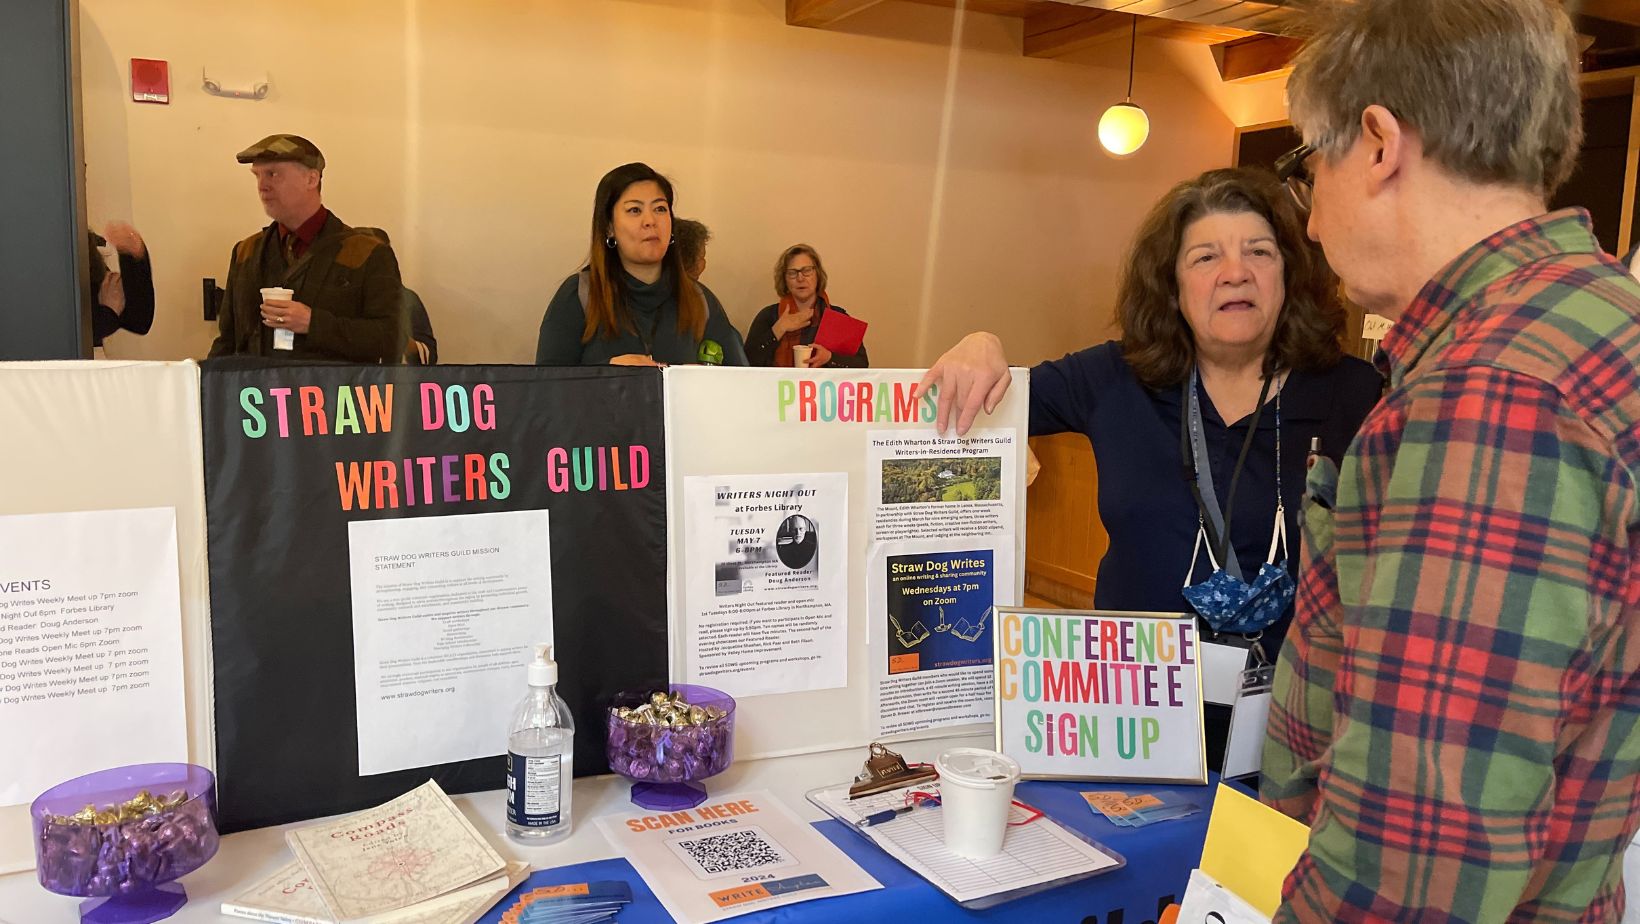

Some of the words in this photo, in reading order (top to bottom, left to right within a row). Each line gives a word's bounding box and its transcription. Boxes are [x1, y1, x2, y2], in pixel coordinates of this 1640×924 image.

[778, 379, 938, 423] PROGRAMS
[239, 383, 394, 439] STRAW
[419, 382, 497, 433] DOG
[962, 447, 989, 455] Program
[335, 452, 511, 511] WRITERS
[546, 444, 650, 493] GUILD
[717, 491, 762, 500] WRITERS
[764, 490, 794, 498] NIGHT
[797, 489, 816, 497] OUT
[774, 504, 803, 512] Library
[730, 528, 766, 536] TUESDAY
[374, 555, 400, 563] STRAW
[419, 551, 449, 559] WRITERS
[451, 549, 471, 557] GUILD
[472, 547, 500, 555] MISSION
[375, 562, 416, 571] STATEMENT
[891, 563, 924, 574] Straw
[926, 561, 948, 573] Dog
[950, 558, 985, 570] Writes
[0, 579, 51, 593] VENTS
[902, 585, 952, 596] Wednesdays
[962, 583, 979, 592] 7pm
[935, 597, 957, 605] Zoom
[1, 611, 21, 620] Night
[39, 609, 56, 617] 6pm
[40, 621, 61, 629] Doug
[63, 618, 99, 626] Anderson
[41, 632, 70, 640] Weekly
[104, 627, 121, 635] 7pm
[1002, 614, 1195, 665] CONFERENCE
[15, 647, 40, 655] Reads
[80, 641, 97, 649] 6pm
[98, 639, 120, 647] Zoom
[1, 661, 17, 669] Dog
[75, 652, 94, 660] Meet
[114, 650, 127, 658] pm
[0, 673, 16, 681] Dog
[17, 671, 42, 679] Writes
[73, 664, 92, 672] Meet
[23, 682, 48, 690] Writes
[49, 679, 77, 687] Weekly
[79, 675, 98, 683] Meet
[111, 673, 128, 681] 7pm
[1000, 658, 1184, 708] COMMITTEE
[47, 691, 76, 699] Weekly
[77, 688, 97, 696] Meet
[1116, 716, 1160, 760] UP
[331, 807, 413, 839] Compass
[625, 811, 696, 833] SCAN
[697, 800, 759, 821] HERE
[350, 821, 406, 841] Roads
[668, 826, 694, 835] FOR
[696, 818, 739, 830] BOOKS
[741, 874, 776, 883] 2024
[717, 889, 764, 903] WRITE
